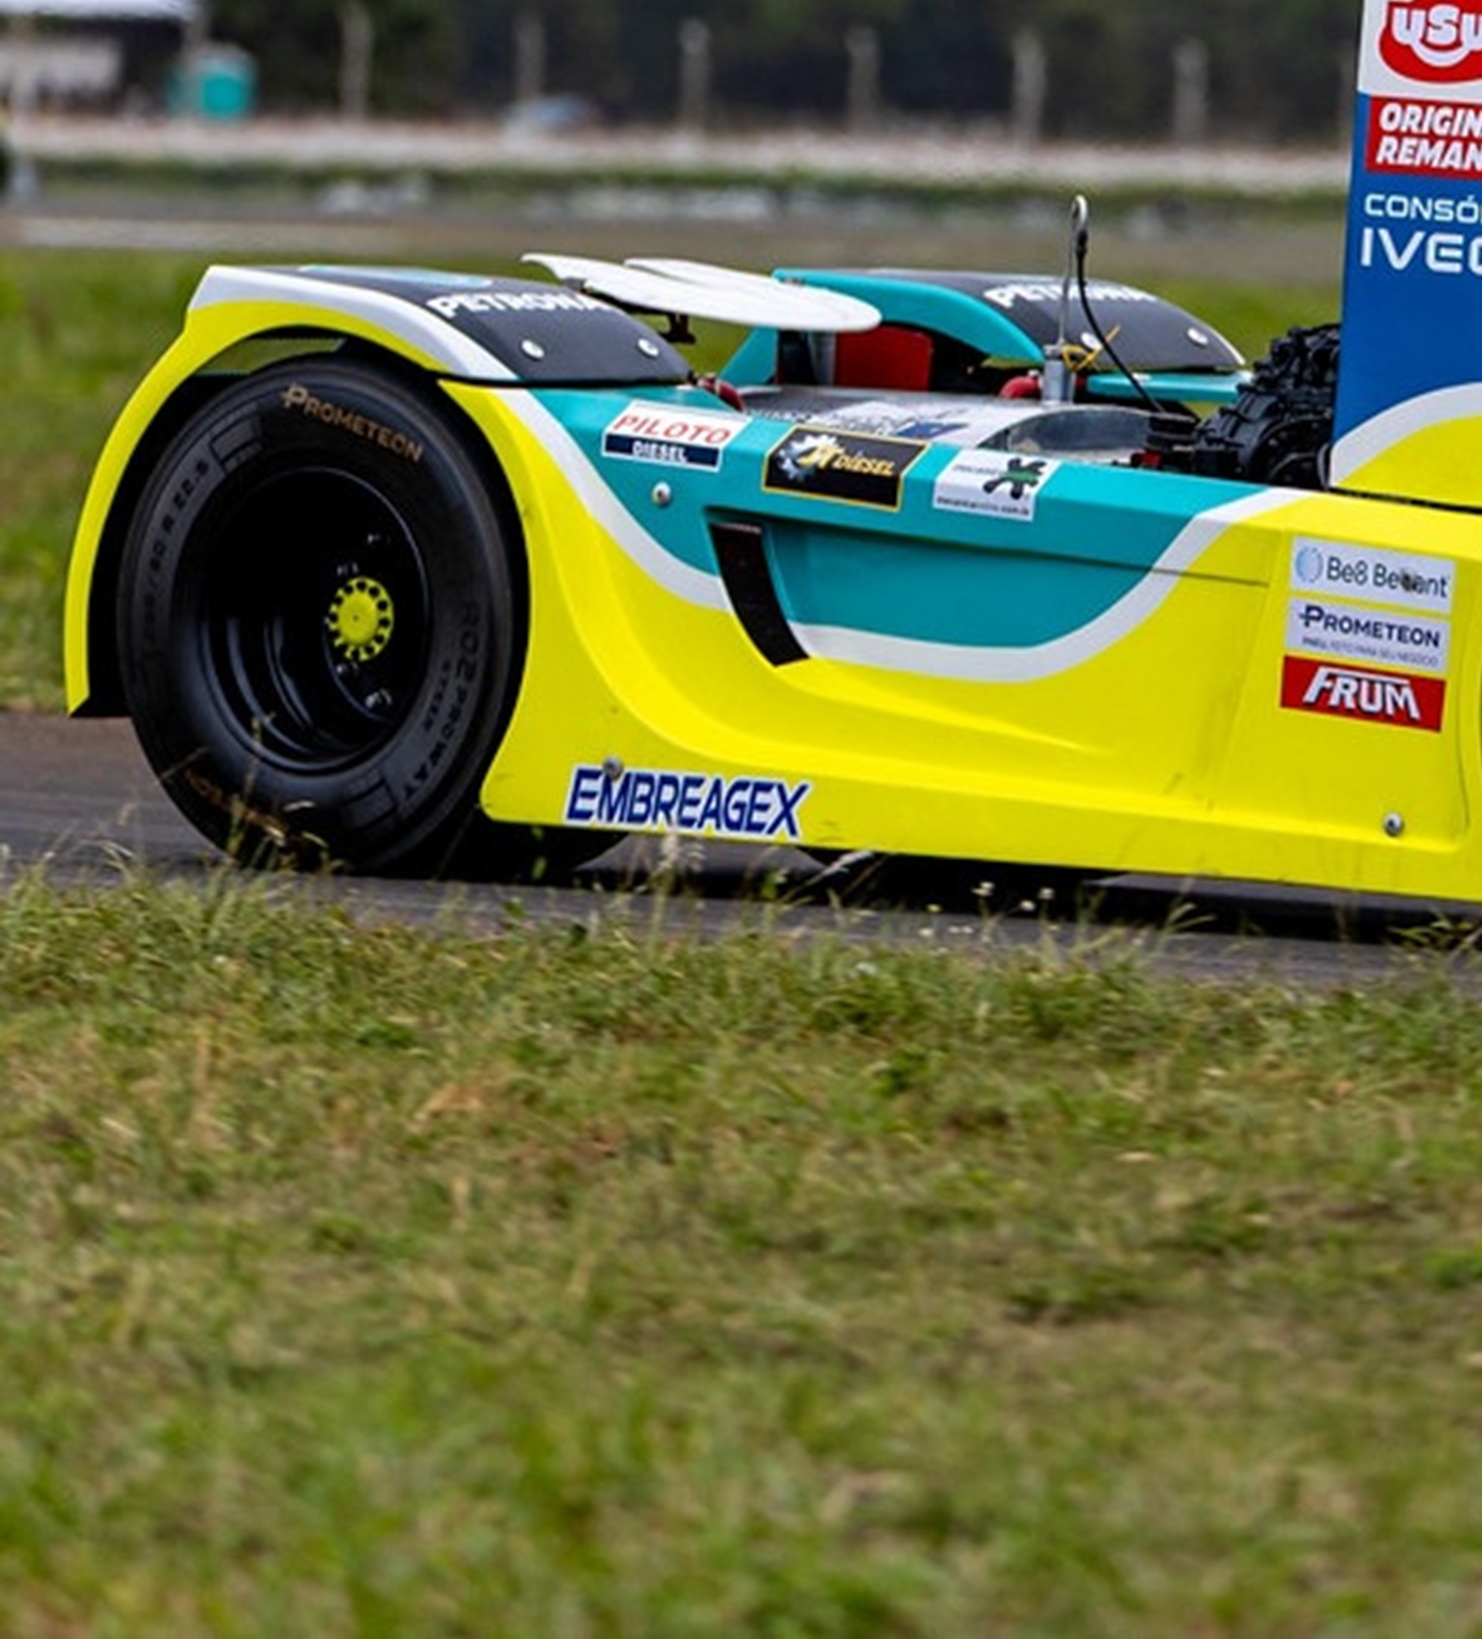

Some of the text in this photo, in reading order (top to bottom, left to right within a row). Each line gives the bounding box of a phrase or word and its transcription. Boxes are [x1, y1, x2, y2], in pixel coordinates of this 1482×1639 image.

[280, 383, 425, 462] PROMETEON
[613, 413, 732, 445] PILOTO
[632, 440, 689, 464] DIESEL
[1326, 556, 1448, 598] Be8 Beant
[1299, 604, 1441, 648] PROMETEON
[1303, 666, 1421, 721] FRUM
[566, 767, 810, 837] EMBREAGEX
